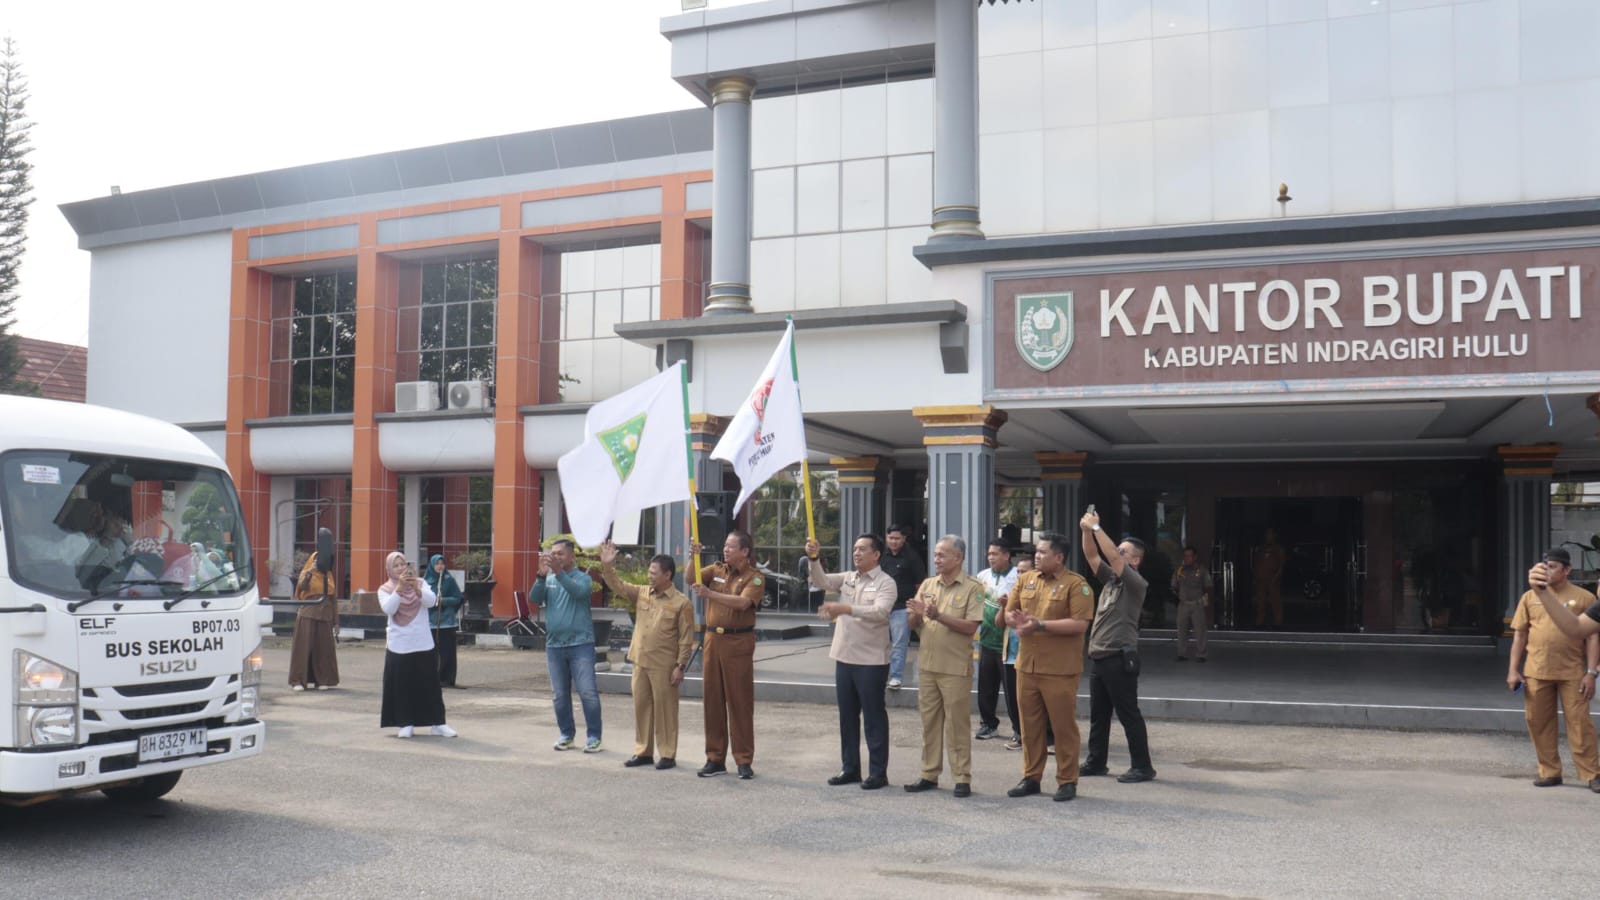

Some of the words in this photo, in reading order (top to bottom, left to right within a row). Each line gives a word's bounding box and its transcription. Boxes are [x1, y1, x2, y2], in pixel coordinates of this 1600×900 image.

[1100, 278, 1344, 338] KANTOR
[1363, 265, 1582, 328] BUPATI
[1144, 342, 1298, 369] KABUPATEN
[1307, 337, 1444, 364] INDRAGIRI
[1453, 334, 1528, 358] HULU
[80, 618, 116, 630] ELF
[192, 618, 241, 634] BP07.03
[105, 641, 142, 658] BUS
[148, 636, 224, 655] SEKOLAH
[139, 658, 198, 677] ISUZU
[141, 736, 156, 753] BH
[159, 732, 186, 751] 8329
